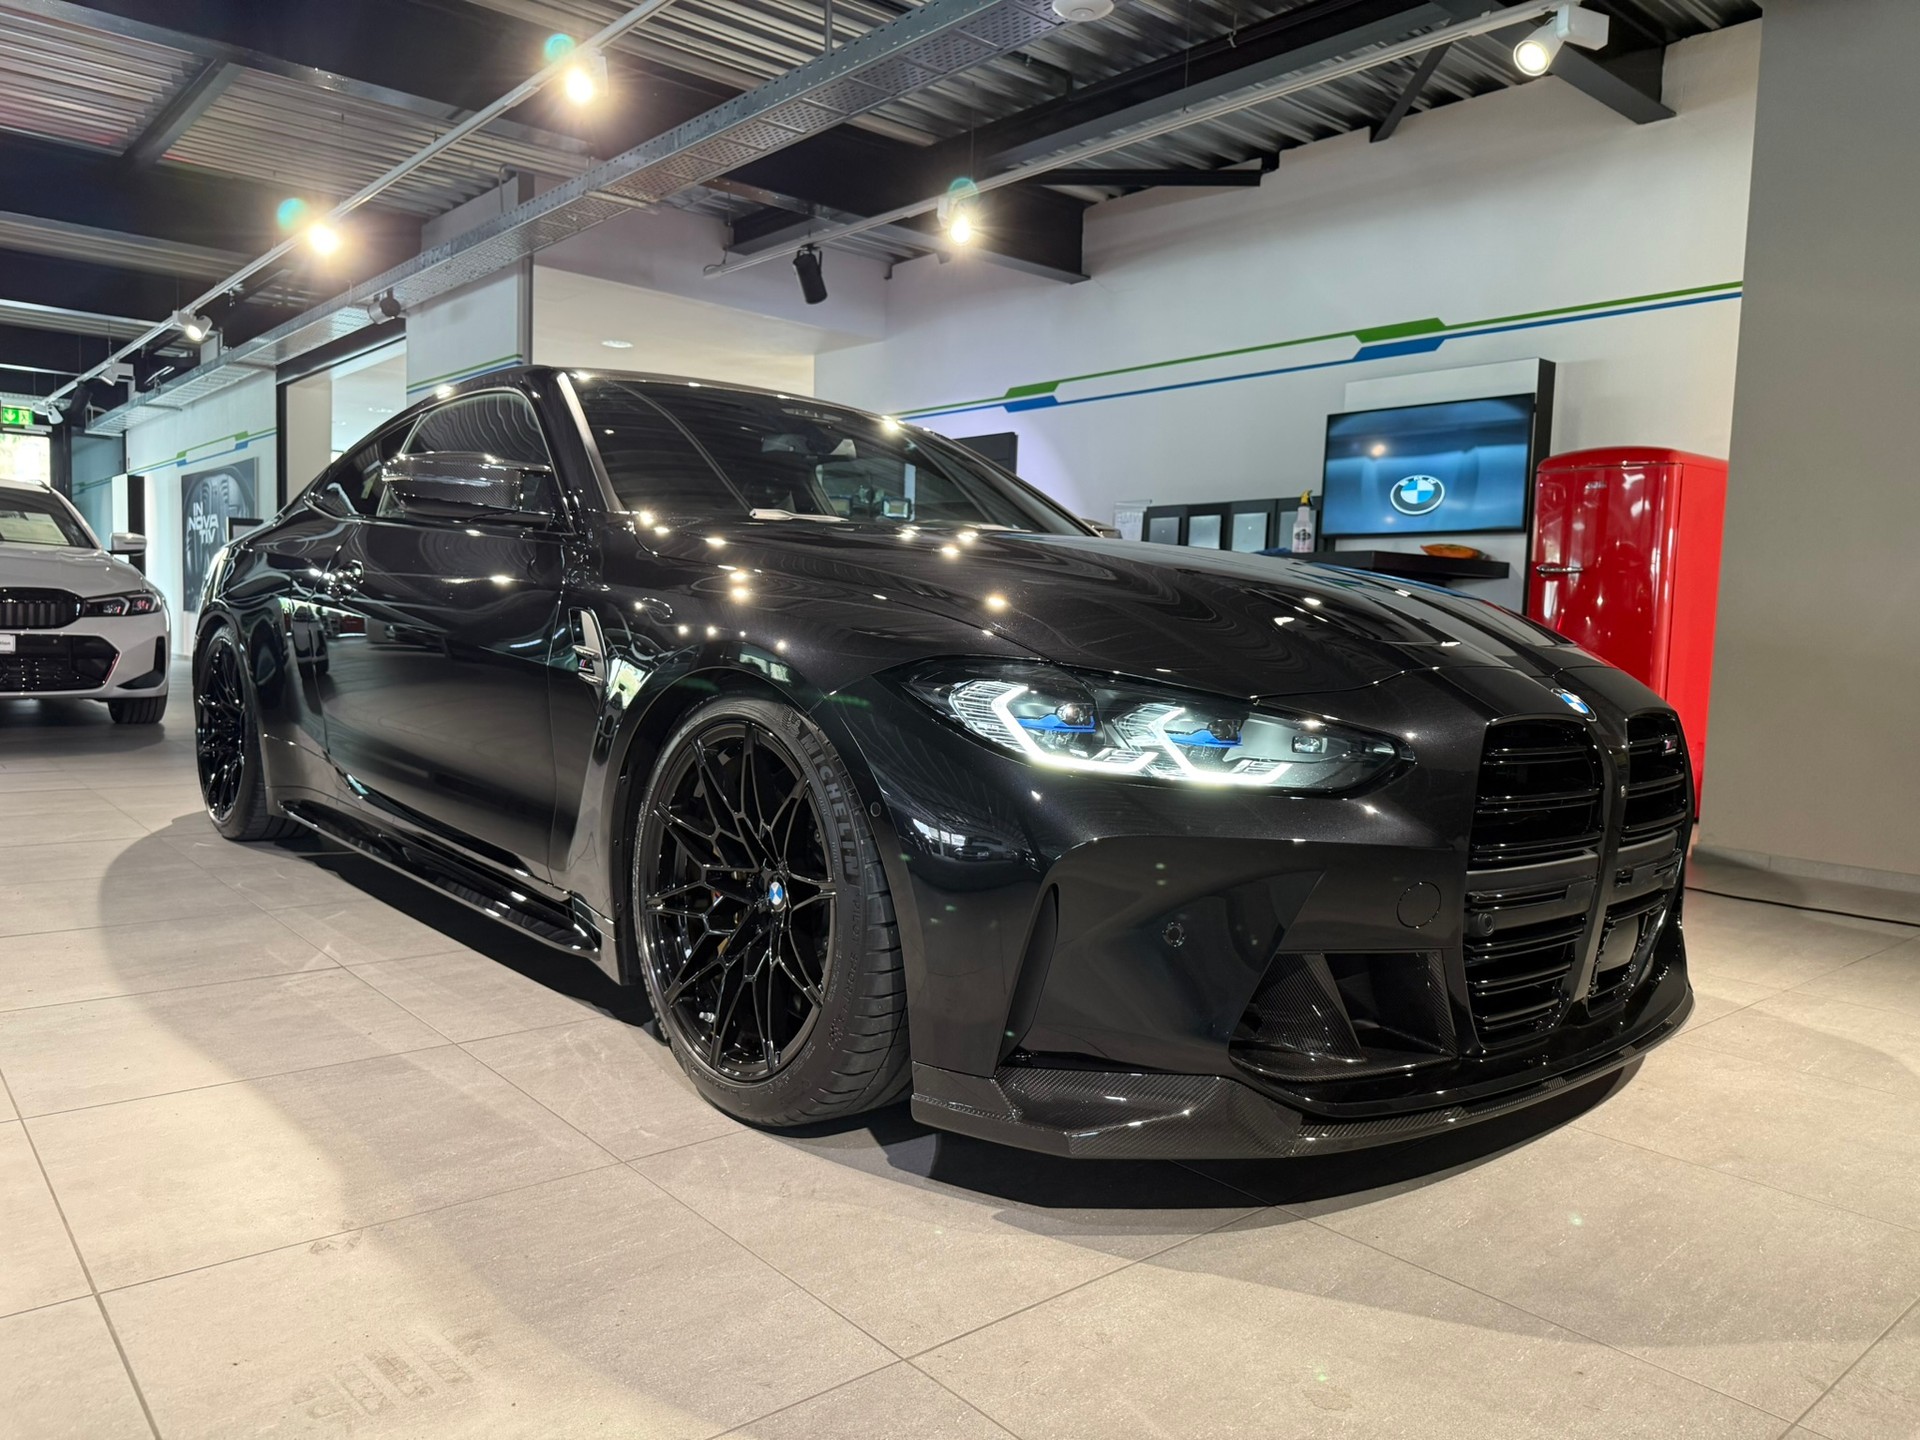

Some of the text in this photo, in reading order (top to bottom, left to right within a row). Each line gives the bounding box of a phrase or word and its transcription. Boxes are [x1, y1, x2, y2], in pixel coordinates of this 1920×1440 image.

[193, 501, 204, 516] IN
[189, 514, 219, 531] NOVA
[199, 528, 216, 544] TIV
[800, 732, 860, 877] MICHELIN
